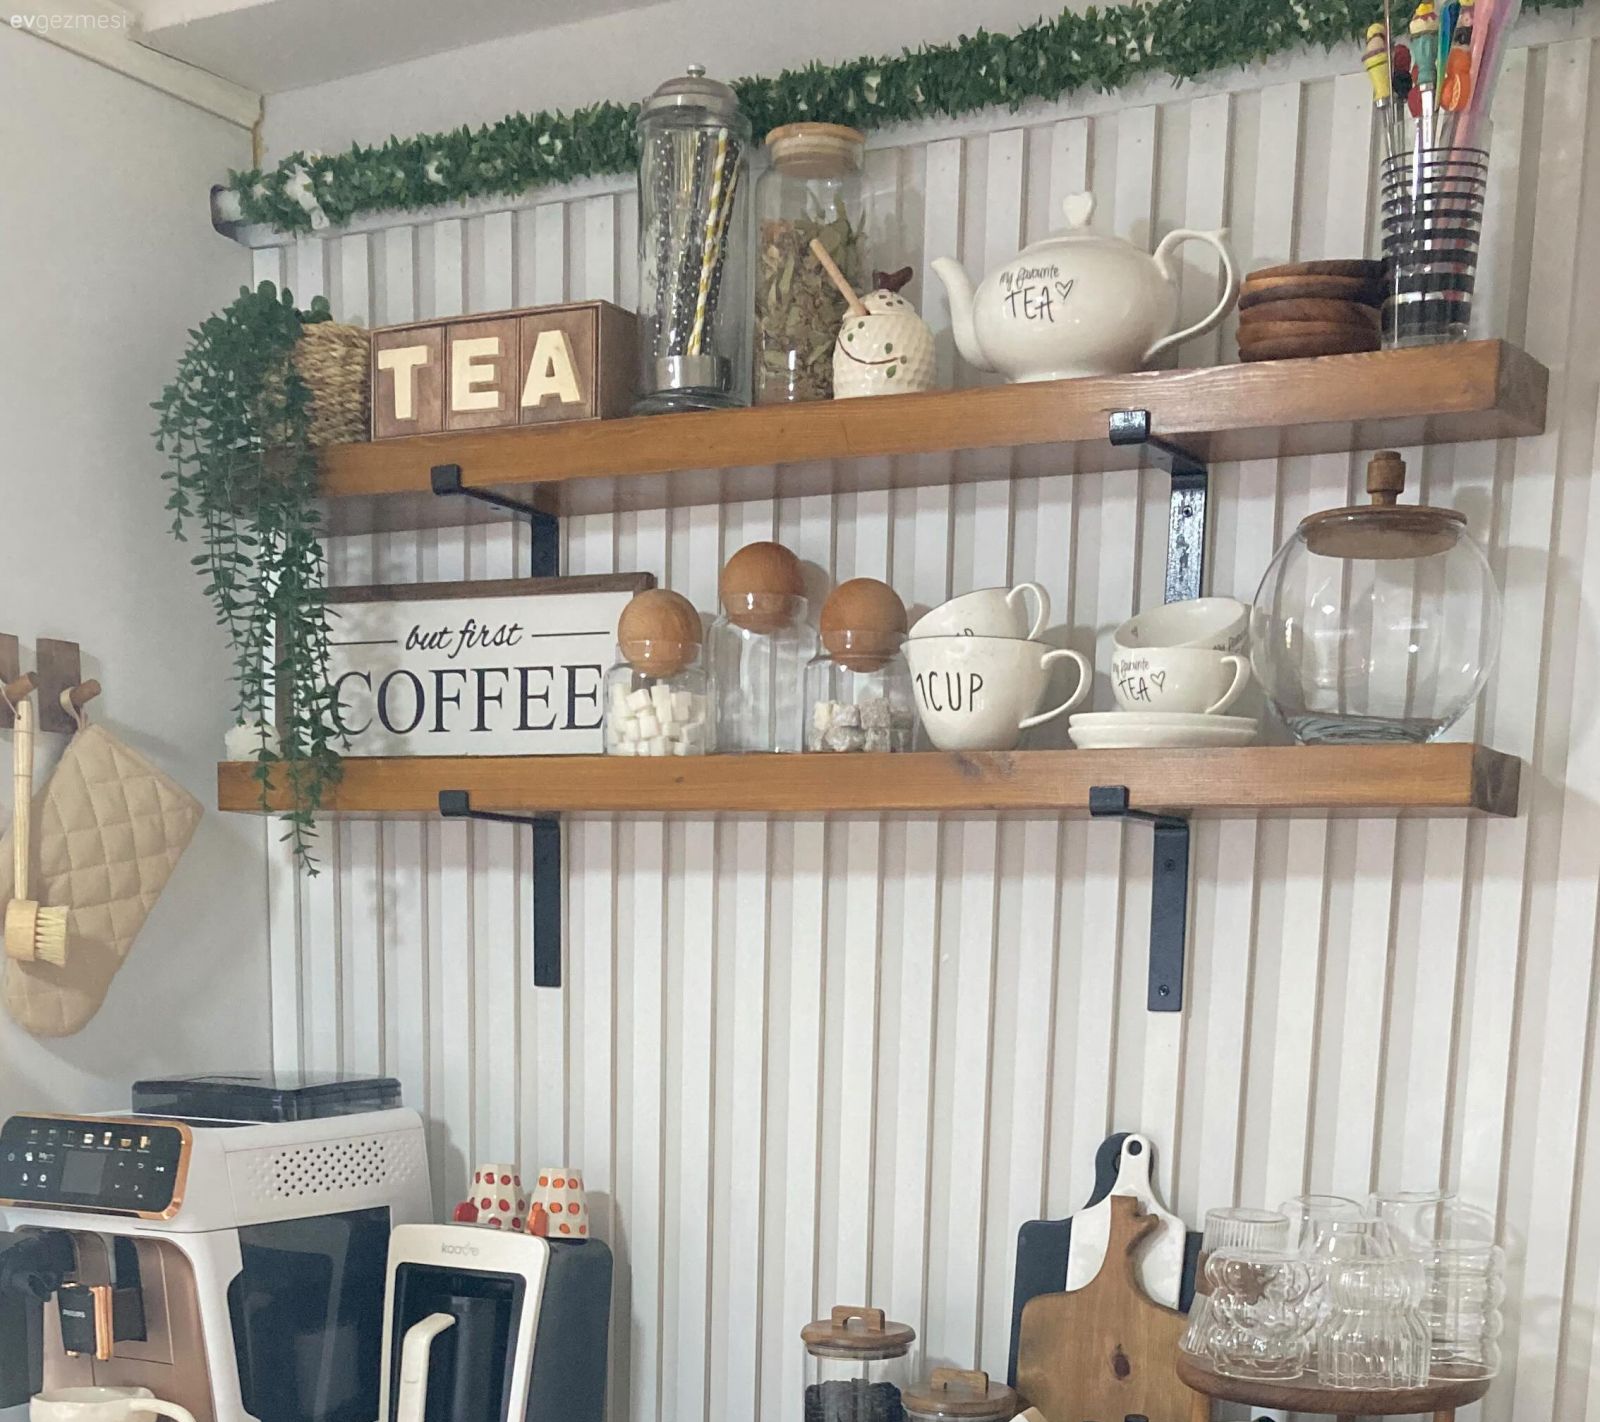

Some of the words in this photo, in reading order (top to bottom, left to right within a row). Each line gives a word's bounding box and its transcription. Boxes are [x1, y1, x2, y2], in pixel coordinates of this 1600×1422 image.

[1004, 286, 1055, 323] TEA
[378, 330, 581, 420] TEA
[405, 623, 452, 651] but
[448, 618, 524, 660] first
[329, 664, 603, 736] COFFEE
[1118, 677, 1152, 703] TEA
